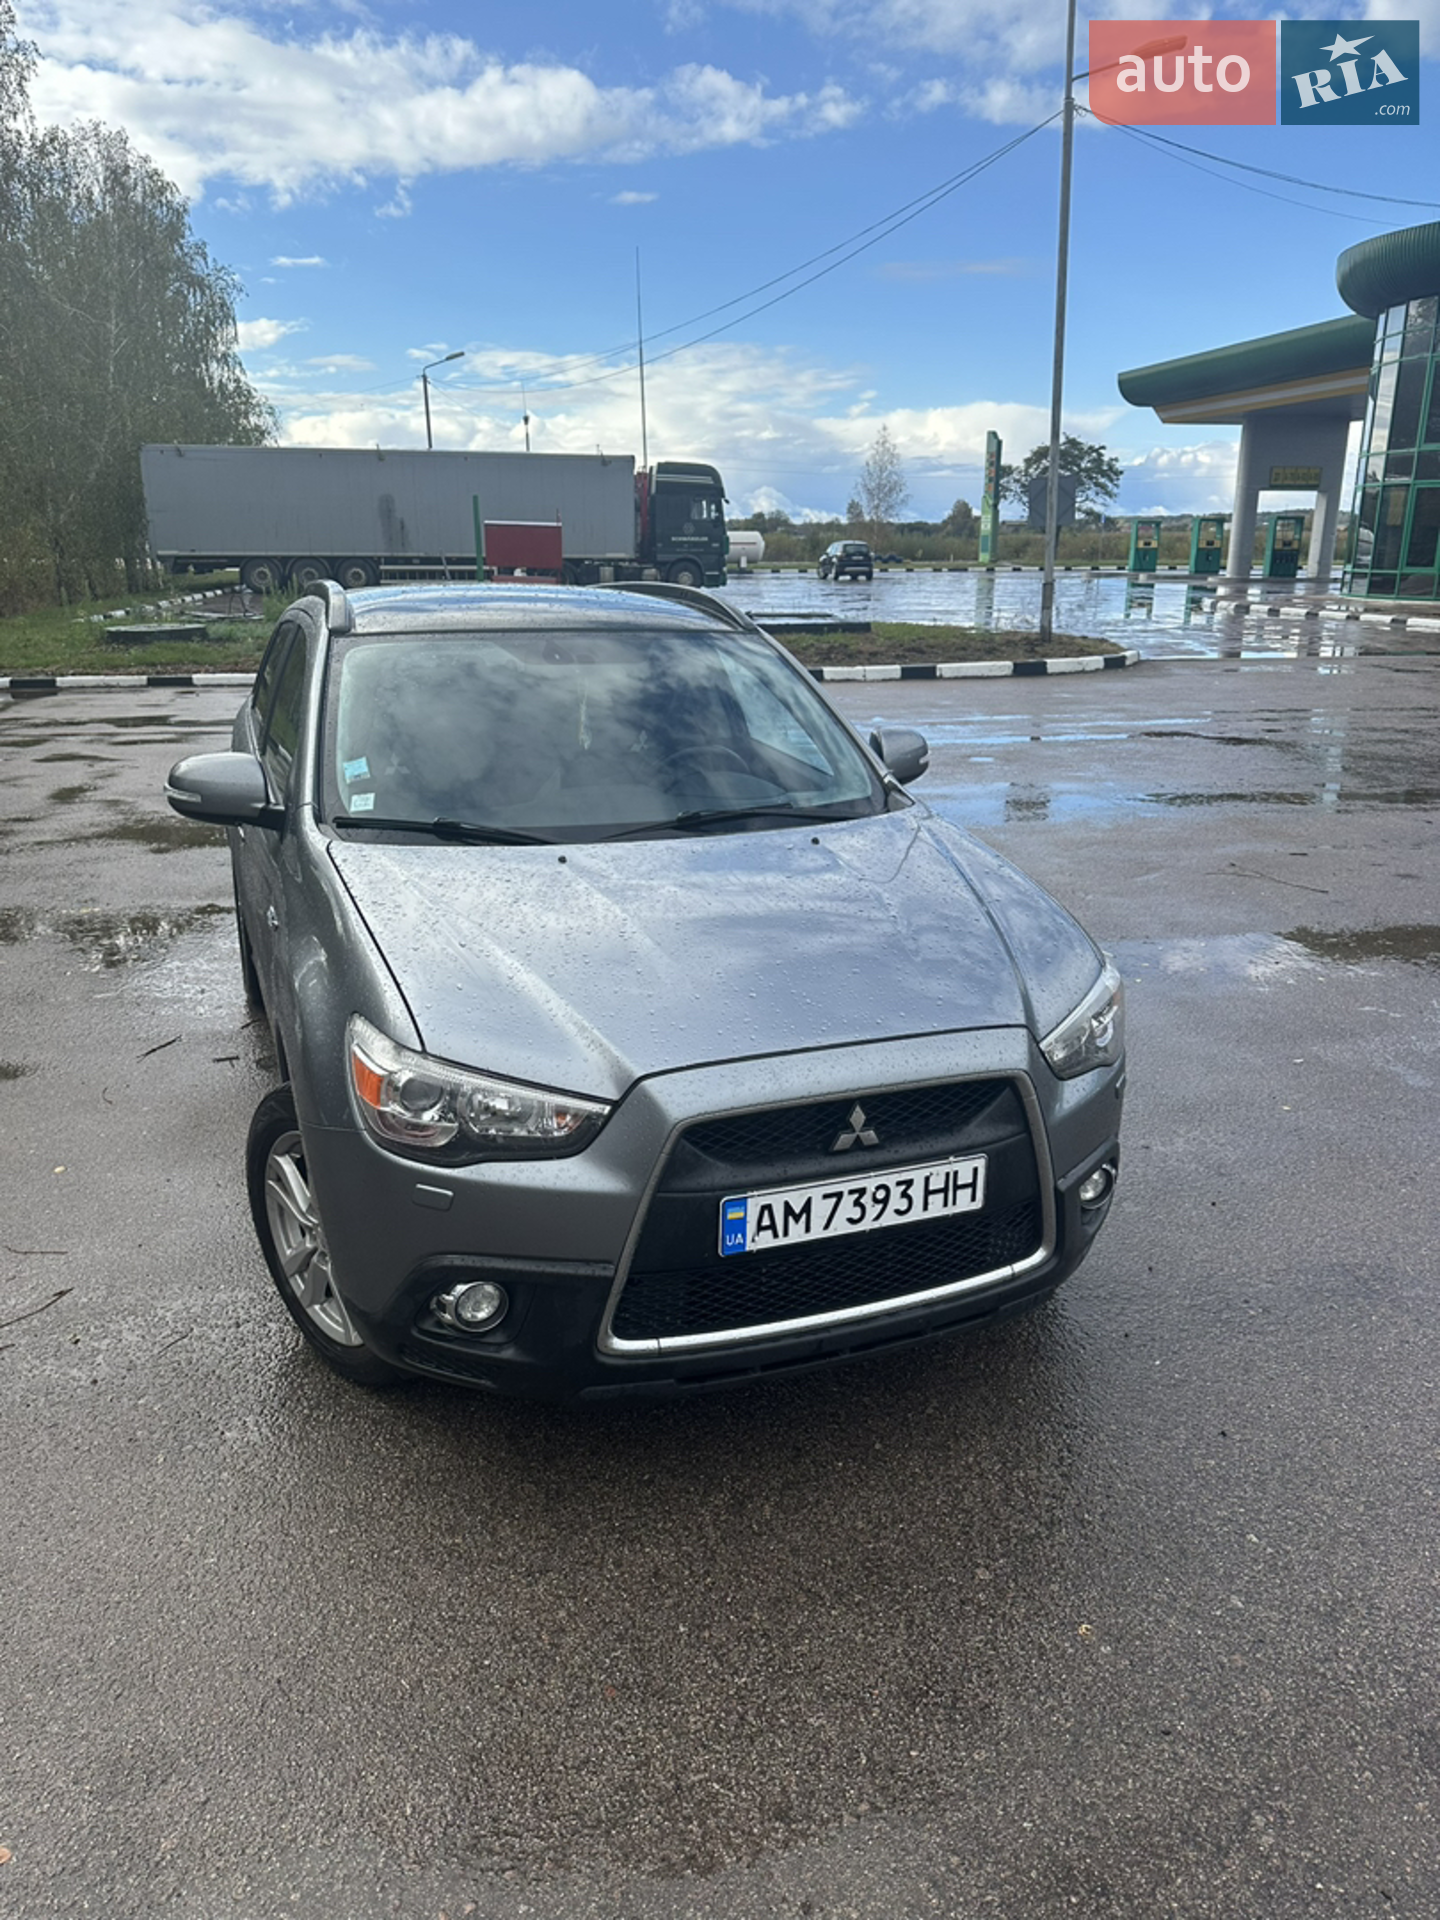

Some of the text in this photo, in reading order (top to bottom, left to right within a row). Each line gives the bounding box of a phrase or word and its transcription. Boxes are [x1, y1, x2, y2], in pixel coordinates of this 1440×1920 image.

[752, 1166, 979, 1243] AM 7393 HH
[725, 1232, 744, 1246] UA
